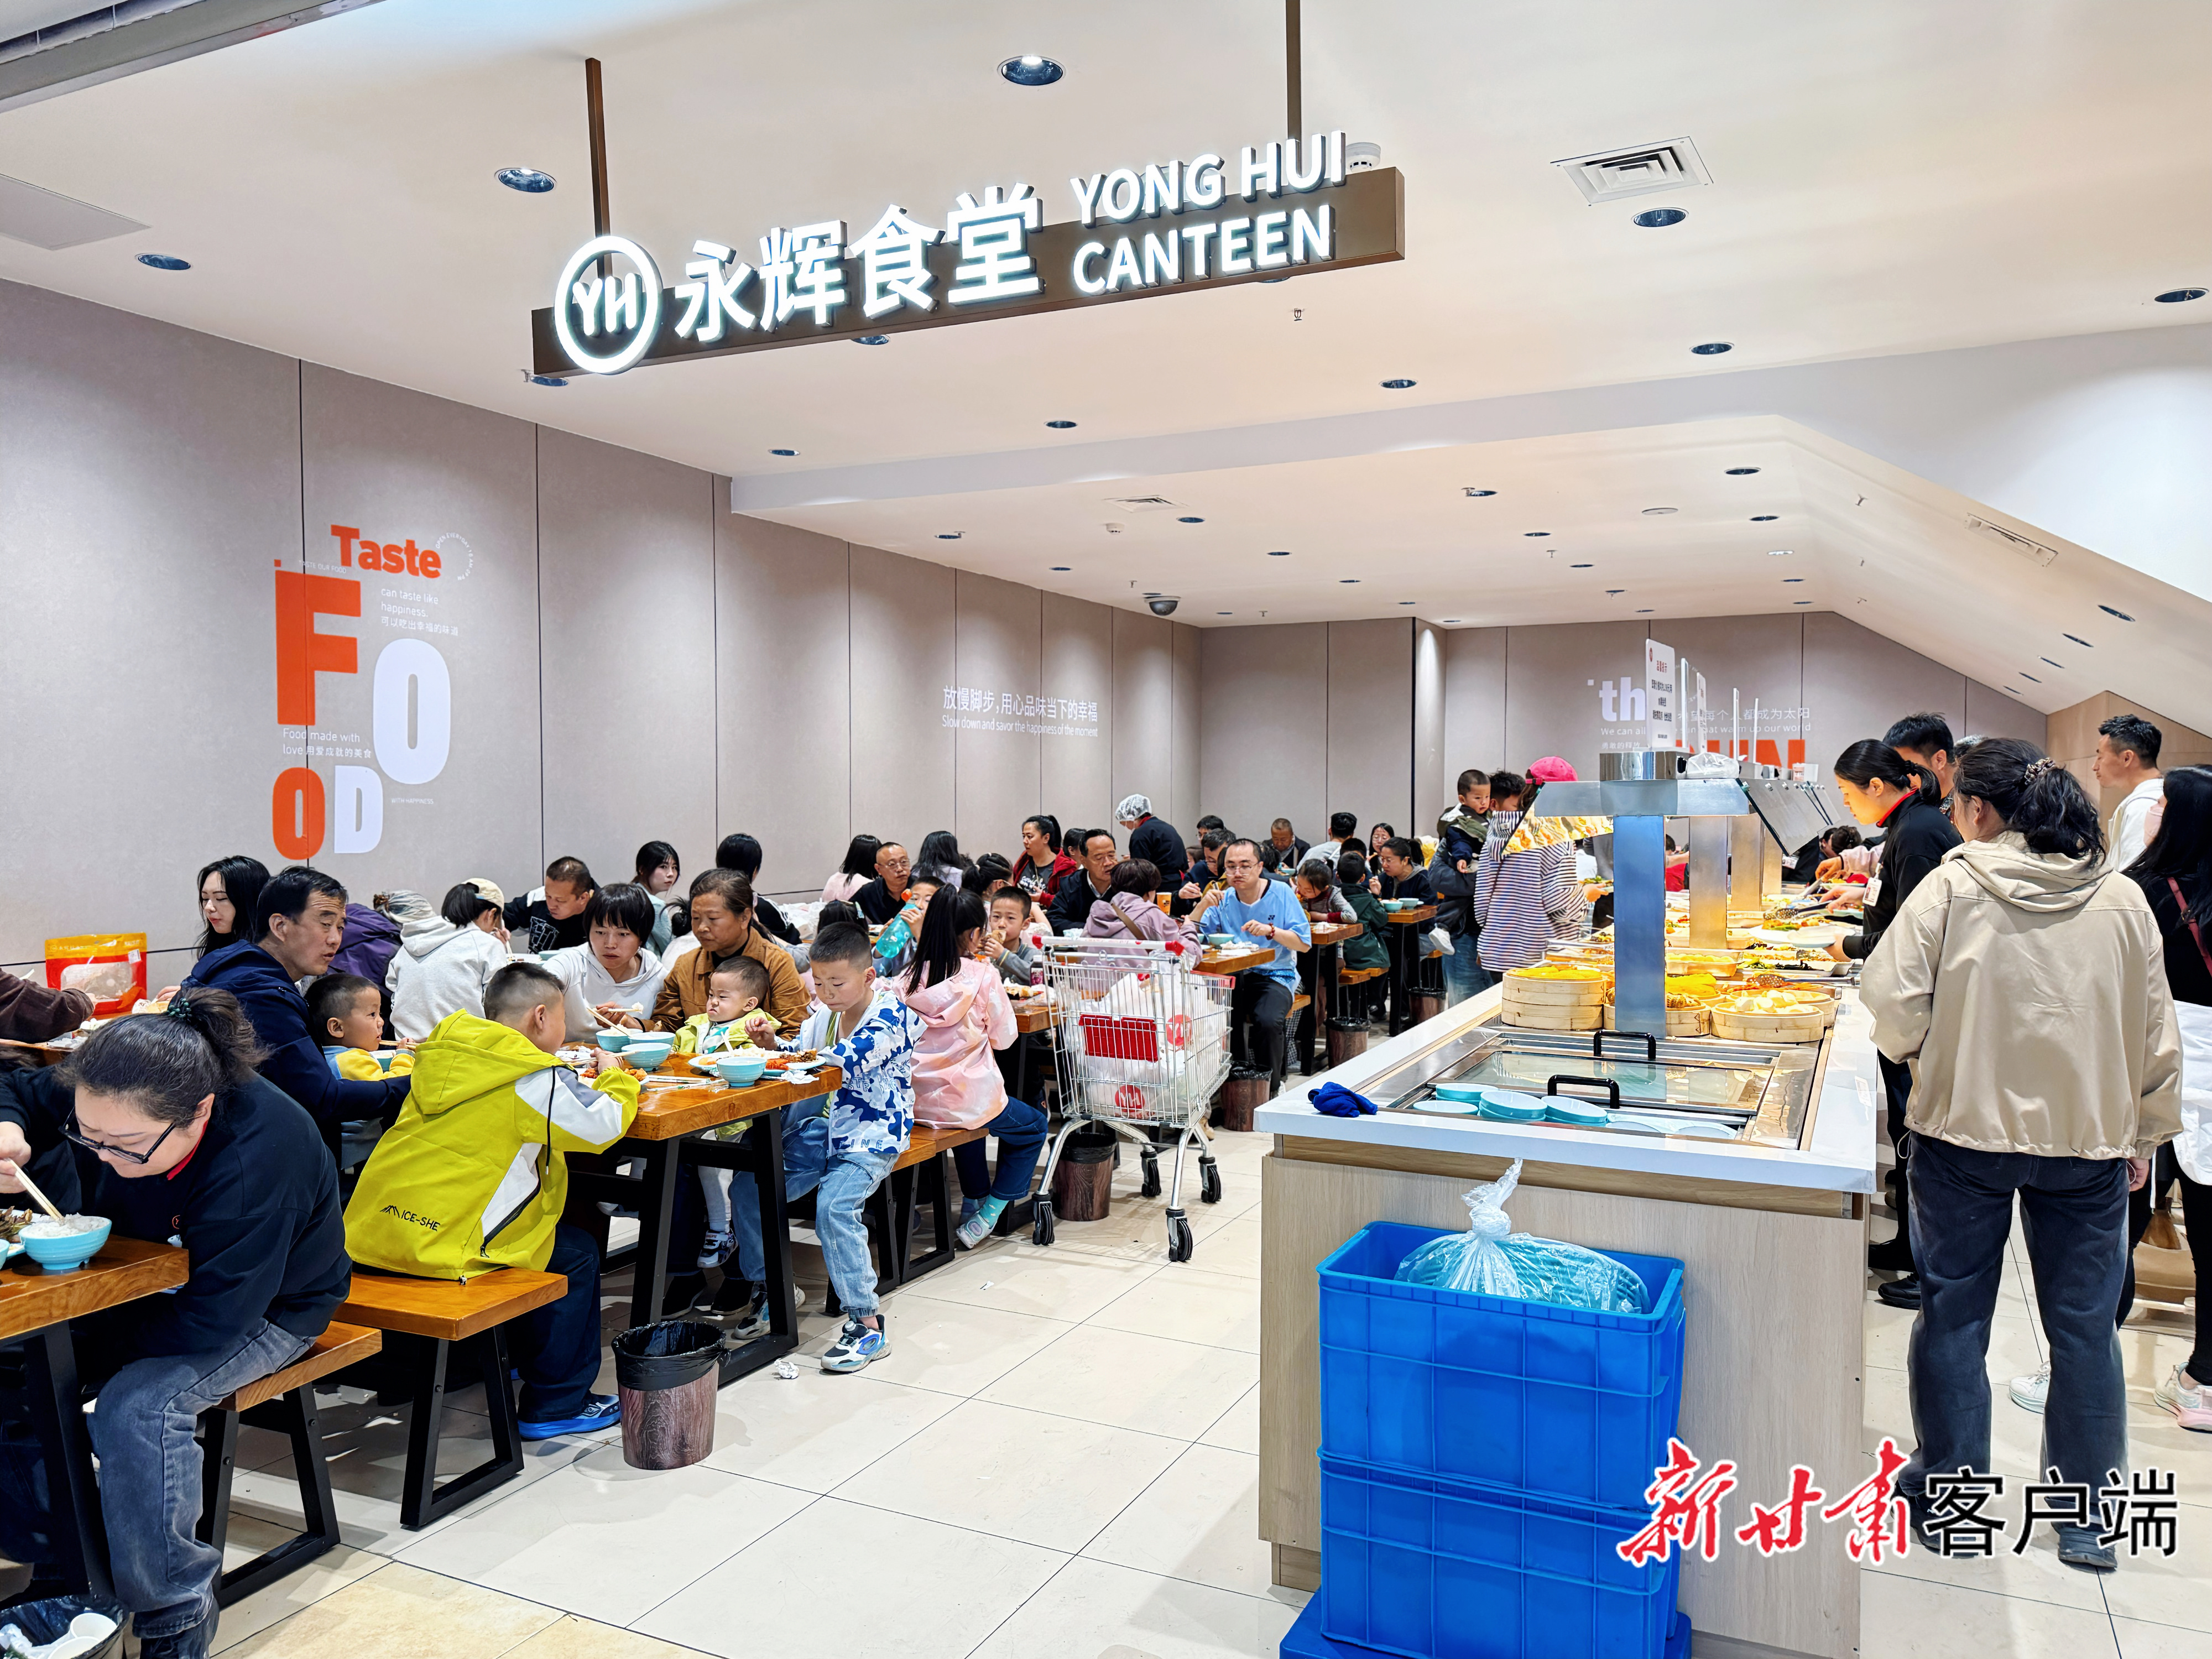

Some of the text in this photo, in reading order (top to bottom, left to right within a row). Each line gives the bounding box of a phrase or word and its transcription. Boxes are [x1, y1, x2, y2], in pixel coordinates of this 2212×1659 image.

[1070, 130, 1346, 226] YONG HUI
[1073, 205, 1334, 295] CANTEEN
[675, 182, 1044, 342] 永辉食堂
[572, 273, 643, 336] YH
[331, 524, 442, 579] Taste
[435, 535, 446, 549] OPEN
[332, 565, 347, 574] FOOD
[381, 588, 439, 604] can taste like
[381, 601, 429, 618] happiness.
[380, 616, 458, 637] 可以吃出幸福的味道
[942, 714, 1098, 737] Slow down and savor the happiness of the moment
[1600, 727, 1615, 735] We
[1635, 726, 1646, 735] all
[1783, 722, 1811, 732] world
[283, 728, 360, 743] Food made with
[283, 743, 372, 759] love 用爱成就的美食
[1120, 1092, 1141, 1107] YH
[401, 1209, 441, 1232] ICE-SHE
